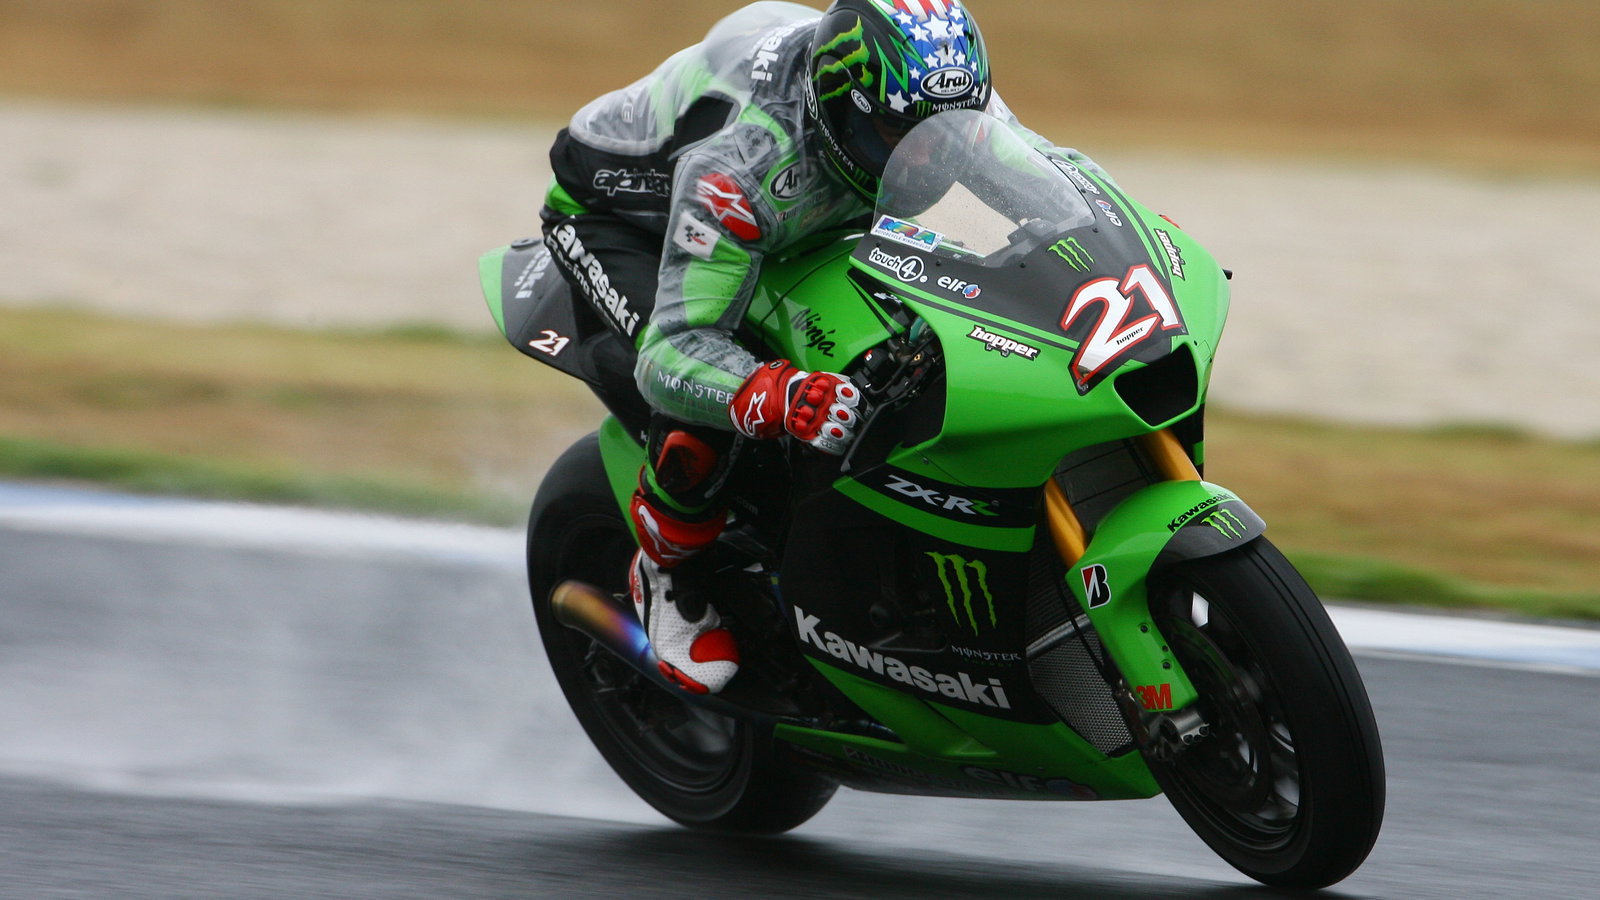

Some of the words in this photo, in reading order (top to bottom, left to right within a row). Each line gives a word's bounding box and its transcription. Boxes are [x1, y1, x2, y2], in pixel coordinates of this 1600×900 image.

[927, 72, 968, 90] Arai
[932, 97, 977, 111] MONSTER
[819, 119, 855, 171] MONSTER
[1155, 229, 1185, 280] hopper
[937, 276, 968, 293] elf
[790, 307, 837, 358] Ninja
[1060, 264, 1182, 386] 21
[1115, 326, 1145, 346] hopper
[528, 329, 570, 357] 21
[969, 325, 1040, 360] hopper
[1167, 493, 1235, 534] Kawasaki
[793, 604, 1012, 710] Kawasaki
[951, 644, 1022, 661] MONSTER
[1136, 683, 1173, 710] 3M
